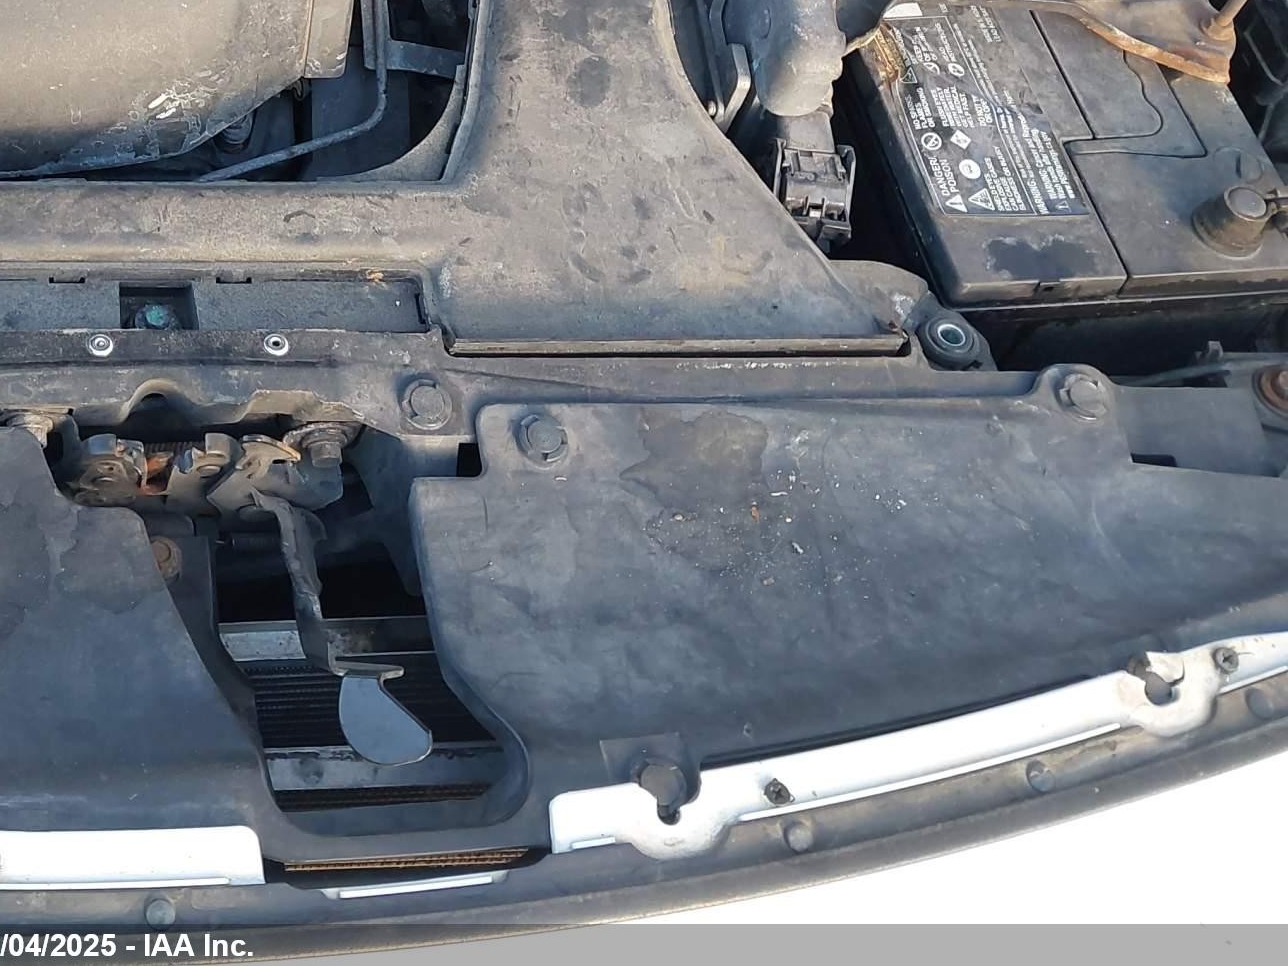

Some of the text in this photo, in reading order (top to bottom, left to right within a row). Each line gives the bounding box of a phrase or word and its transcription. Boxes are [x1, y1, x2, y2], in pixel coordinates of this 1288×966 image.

[916, 87, 933, 116] SMOKING
[960, 115, 969, 128] GET
[964, 111, 976, 128] HELP
[939, 159, 959, 192] POISON
[1003, 167, 1011, 176] OR
